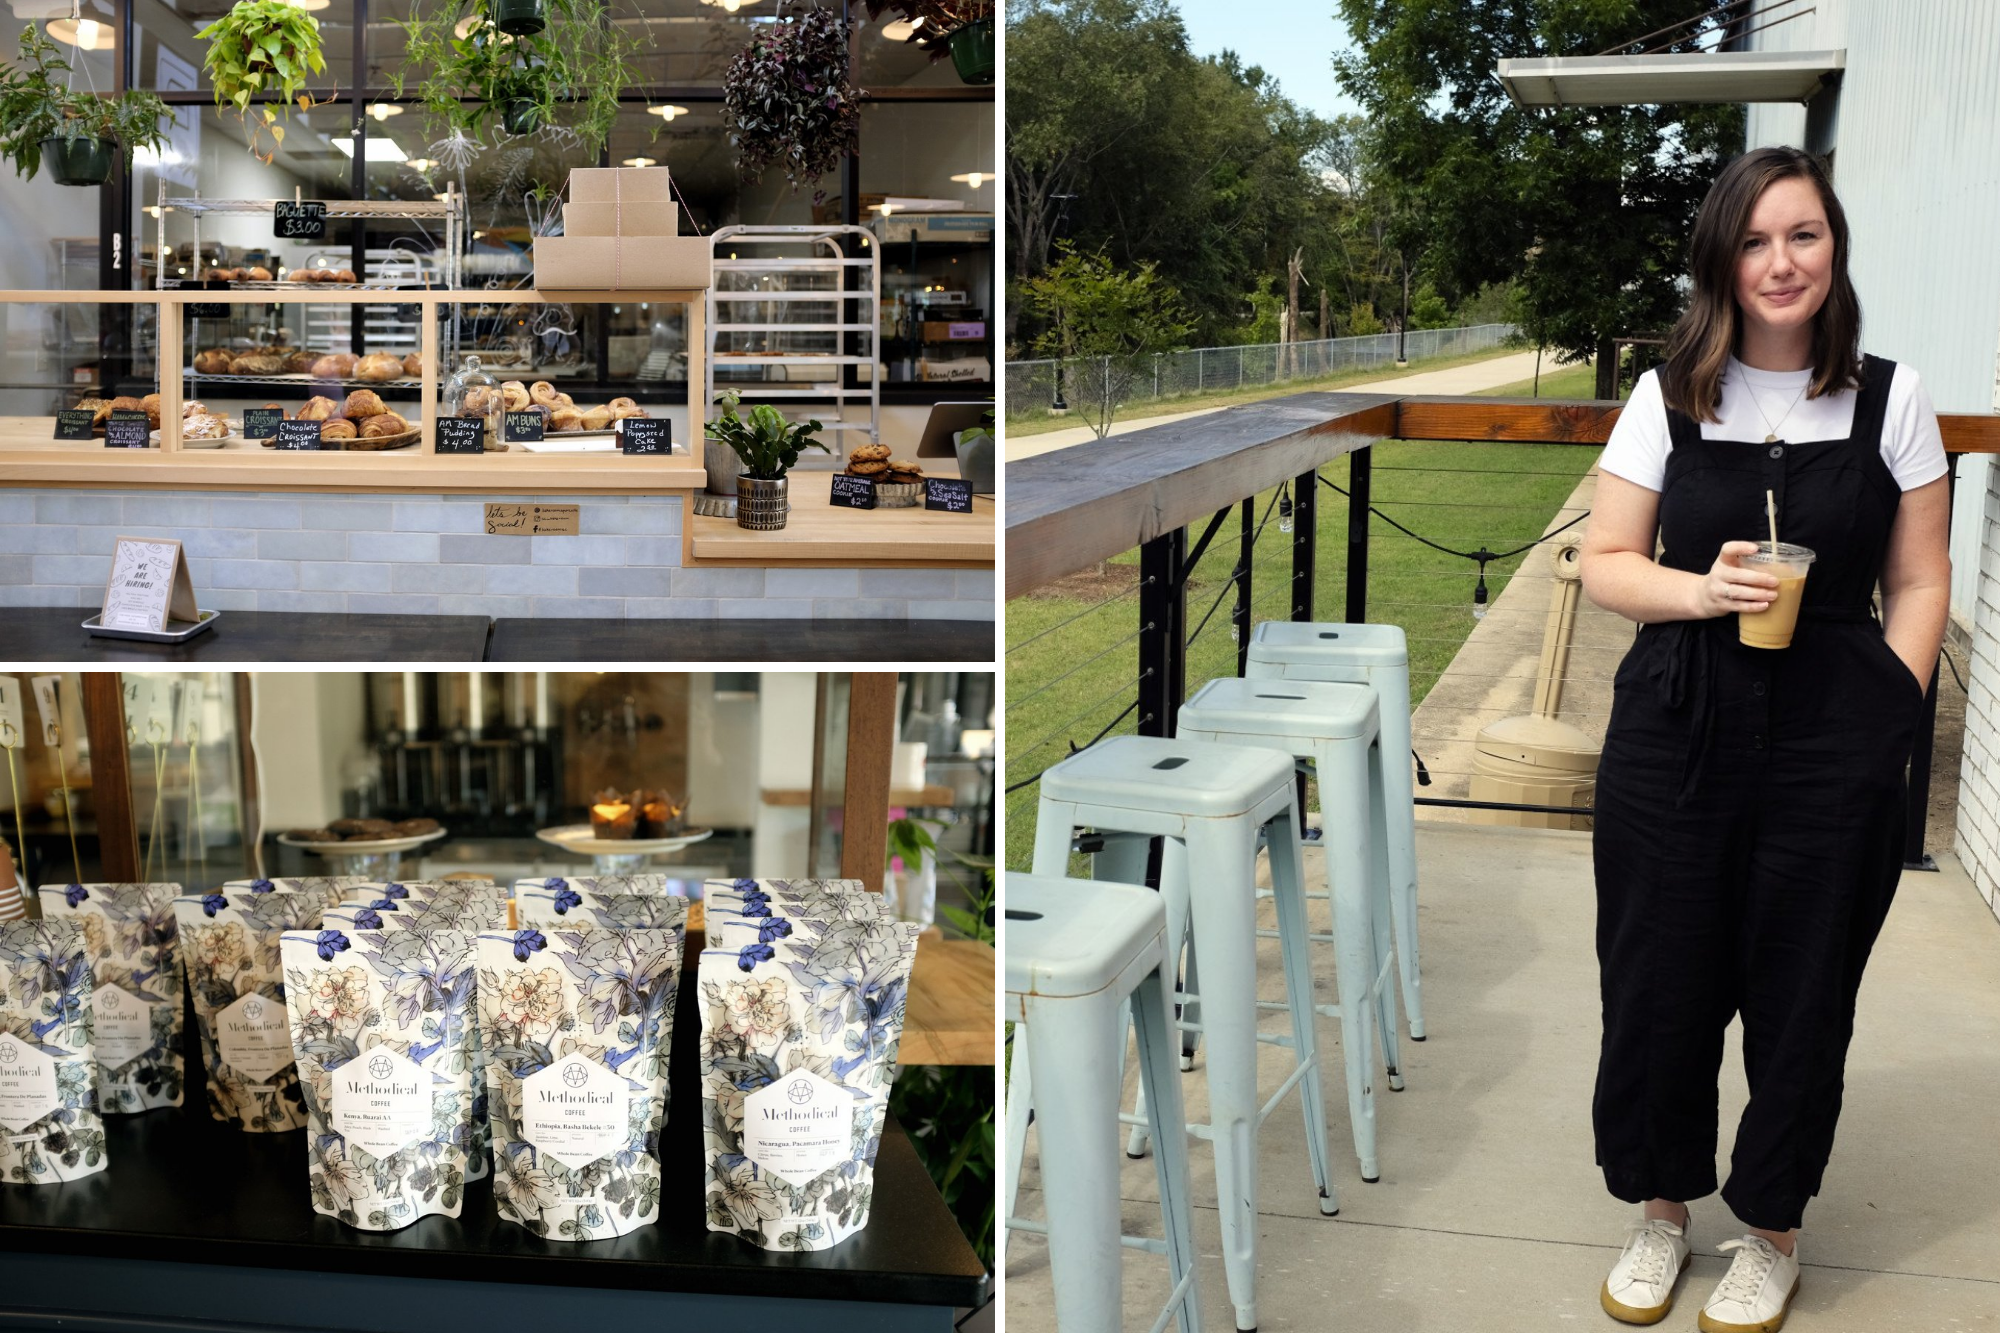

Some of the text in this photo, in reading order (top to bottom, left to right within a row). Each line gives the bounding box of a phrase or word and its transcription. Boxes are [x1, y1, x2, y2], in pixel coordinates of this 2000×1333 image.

[276, 202, 326, 218] BAGUETTE
[283, 219, 321, 236] $3.00
[951, 367, 975, 378] Shelled
[58, 411, 93, 419] EVERYTHING
[506, 414, 541, 427] AM BUNS
[280, 422, 318, 431] Chocolate
[438, 420, 480, 429] AM Bread
[115, 431, 147, 441] ALMOND
[441, 428, 475, 439] Pudding
[834, 480, 870, 495] OATMEAL
[928, 479, 966, 492] Chocolate
[833, 489, 853, 497] COOKIE
[937, 489, 952, 499] Sea
[952, 491, 968, 501] Salt
[512, 506, 528, 518] be
[137, 563, 148, 571] WE
[133, 572, 148, 580] ARE
[125, 580, 154, 590] HIRING!
[94, 1011, 138, 1021] ethodical
[228, 1019, 284, 1032] Methodical
[0, 1065, 41, 1077] hodical
[346, 1081, 418, 1095] Methodical
[539, 1090, 613, 1104] Methodical
[762, 1105, 838, 1121] Methodical
[535, 1122, 563, 1131] Ethiopia,
[758, 1140, 791, 1148] Nicaragua,
